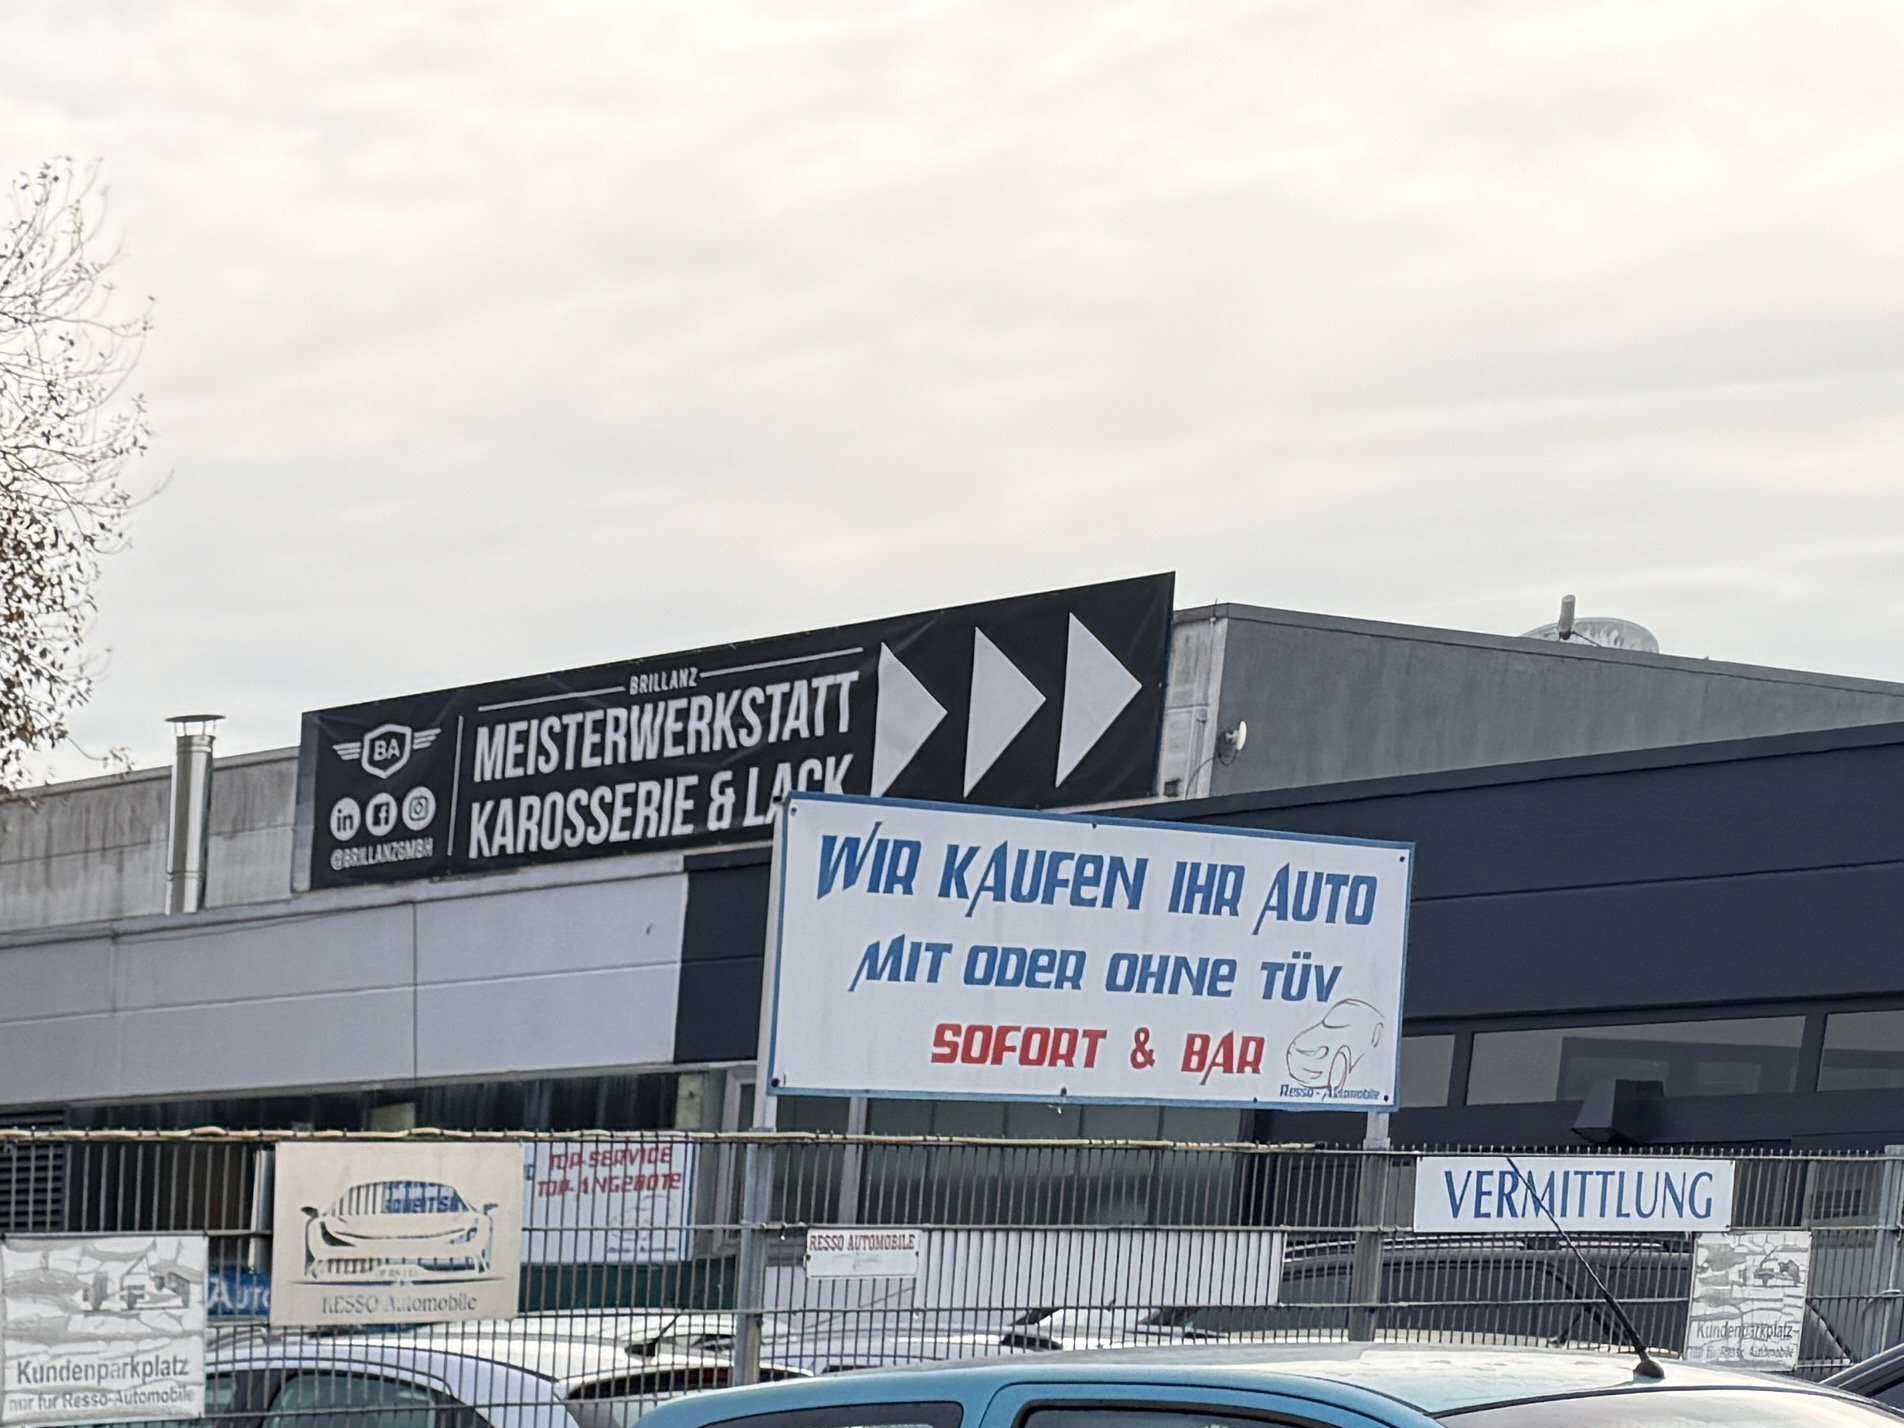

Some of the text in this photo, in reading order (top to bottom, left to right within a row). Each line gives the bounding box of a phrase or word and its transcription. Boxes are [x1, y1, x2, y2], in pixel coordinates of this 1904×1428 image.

[629, 668, 697, 695] BRILLANZ
[374, 738, 400, 761] BA
[473, 671, 860, 782] MEISTERWERKSTATT
[468, 754, 854, 859] KAROSSERIE & LACK
[816, 821, 921, 899] WIR
[1168, 860, 1245, 917] IHR
[1252, 862, 1378, 935] AUTO
[848, 933, 1343, 1003] MIT ODER OHNE TÜV
[931, 1022, 1265, 1086] SOFORT & BAR
[1444, 1169, 1713, 1221] VERMITTLUNG
[16, 1354, 189, 1387] Kundenparkplatz
